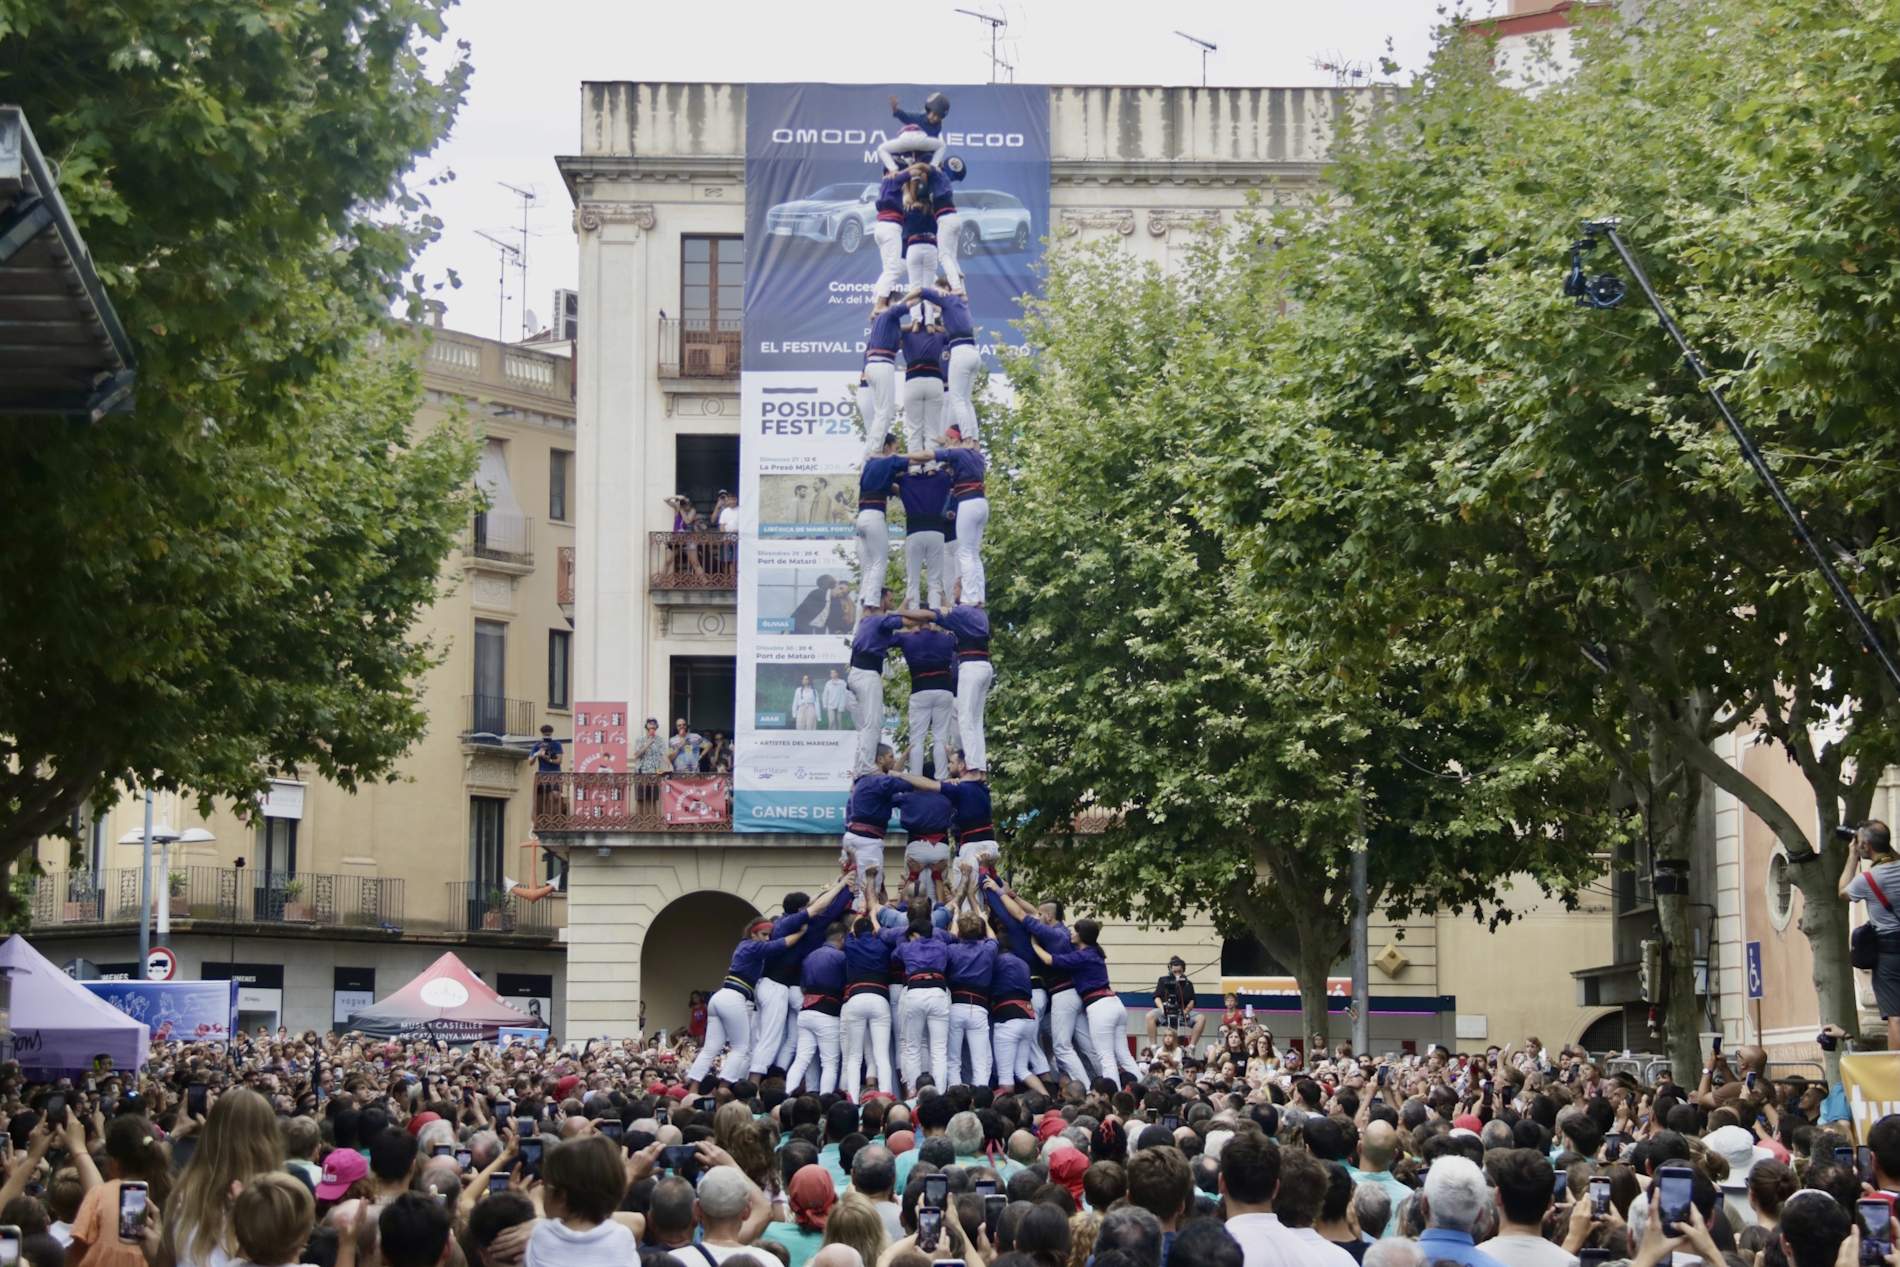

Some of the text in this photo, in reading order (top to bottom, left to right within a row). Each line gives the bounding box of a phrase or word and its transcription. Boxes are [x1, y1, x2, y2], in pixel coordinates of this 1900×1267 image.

[828, 295, 844, 304] Av.
[846, 295, 862, 304] del
[760, 342, 779, 353] EL
[782, 342, 852, 353] FESTIVAL
[855, 342, 868, 353] D
[756, 652, 774, 660] Port
[775, 652, 786, 660] de
[751, 805, 810, 820] GANES
[812, 805, 836, 819] DE
[435, 1021, 483, 1030] CASTELLER
